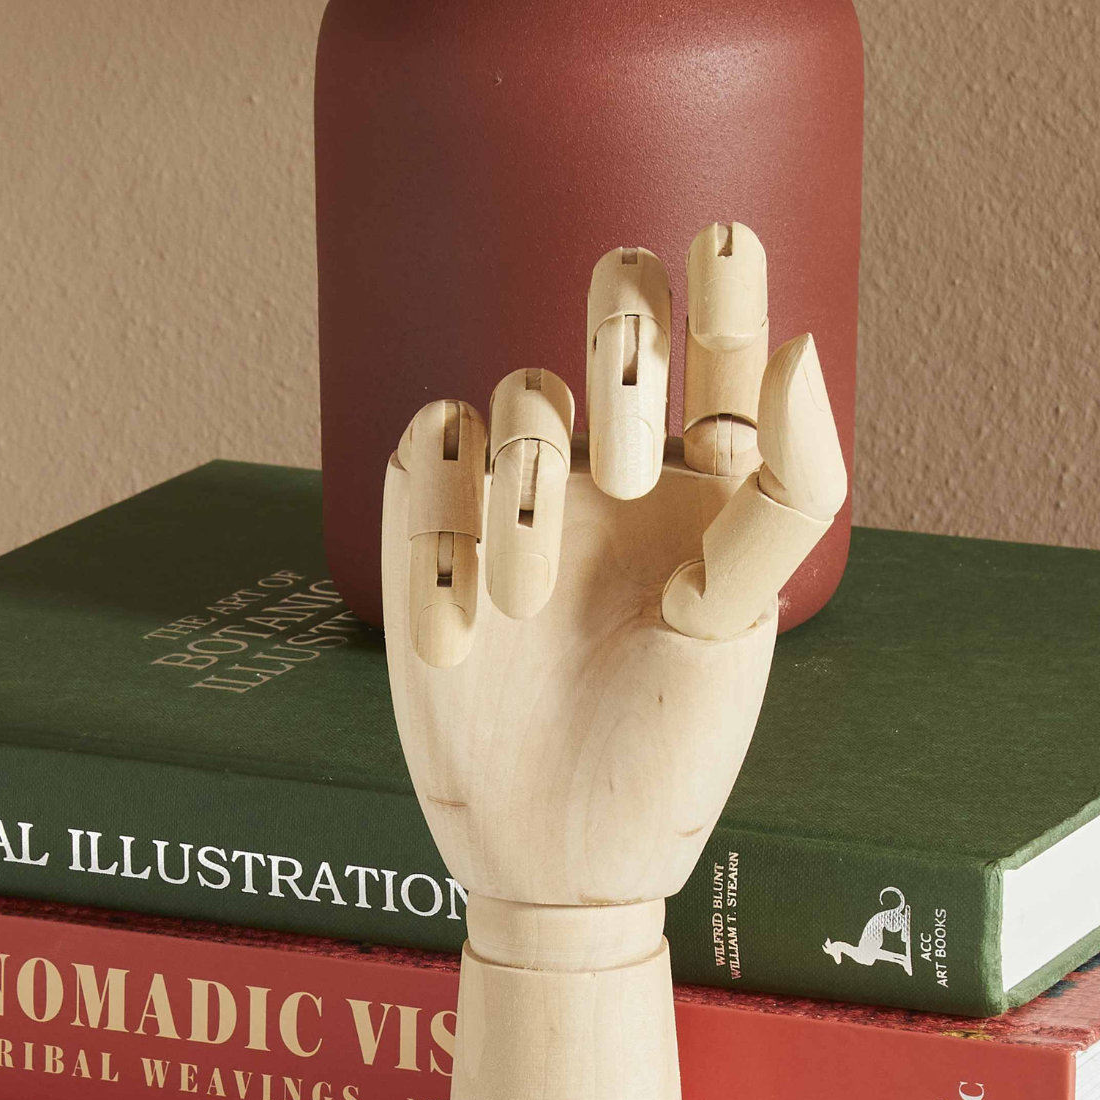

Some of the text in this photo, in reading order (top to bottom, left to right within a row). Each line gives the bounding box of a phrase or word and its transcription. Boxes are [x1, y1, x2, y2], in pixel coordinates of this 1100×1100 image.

[143, 569, 306, 640] THE ART OF
[711, 862, 726, 967] WILFRID BLUNT
[726, 850, 742, 980] WILLIAM T. STEARN
[920, 932, 932, 962] ACC
[934, 908, 949, 988] ART BOOKS
